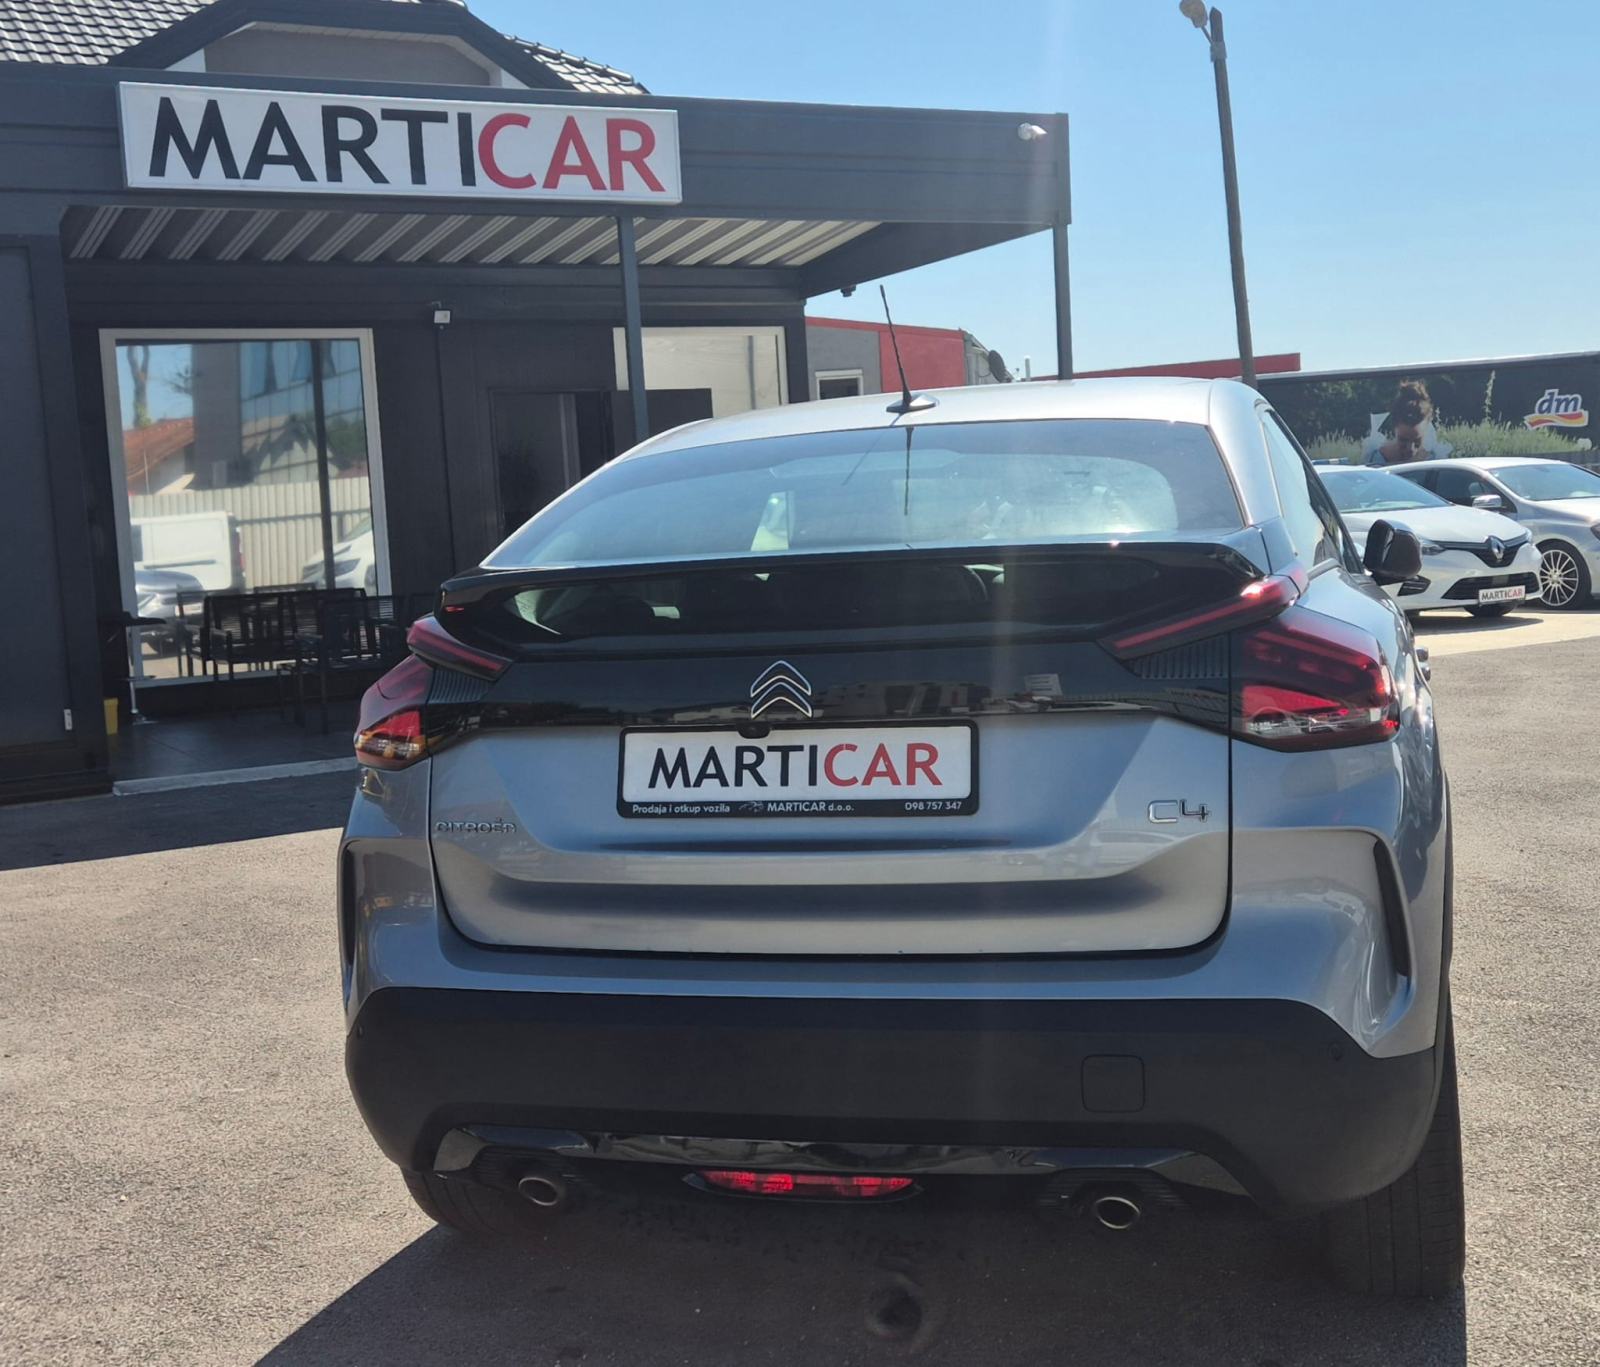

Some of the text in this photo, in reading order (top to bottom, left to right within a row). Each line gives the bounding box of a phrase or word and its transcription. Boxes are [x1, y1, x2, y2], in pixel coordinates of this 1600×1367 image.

[149, 96, 666, 192] MARTICAR
[1537, 390, 1580, 414] dm
[648, 742, 943, 790] MARTICAR
[632, 804, 667, 814] Prodaja
[674, 804, 701, 814] otkup
[703, 803, 730, 813] vozila
[767, 801, 855, 812] MARTICAR d.o.o.
[905, 801, 962, 810] 098 757 347
[1147, 799, 1209, 824] C4
